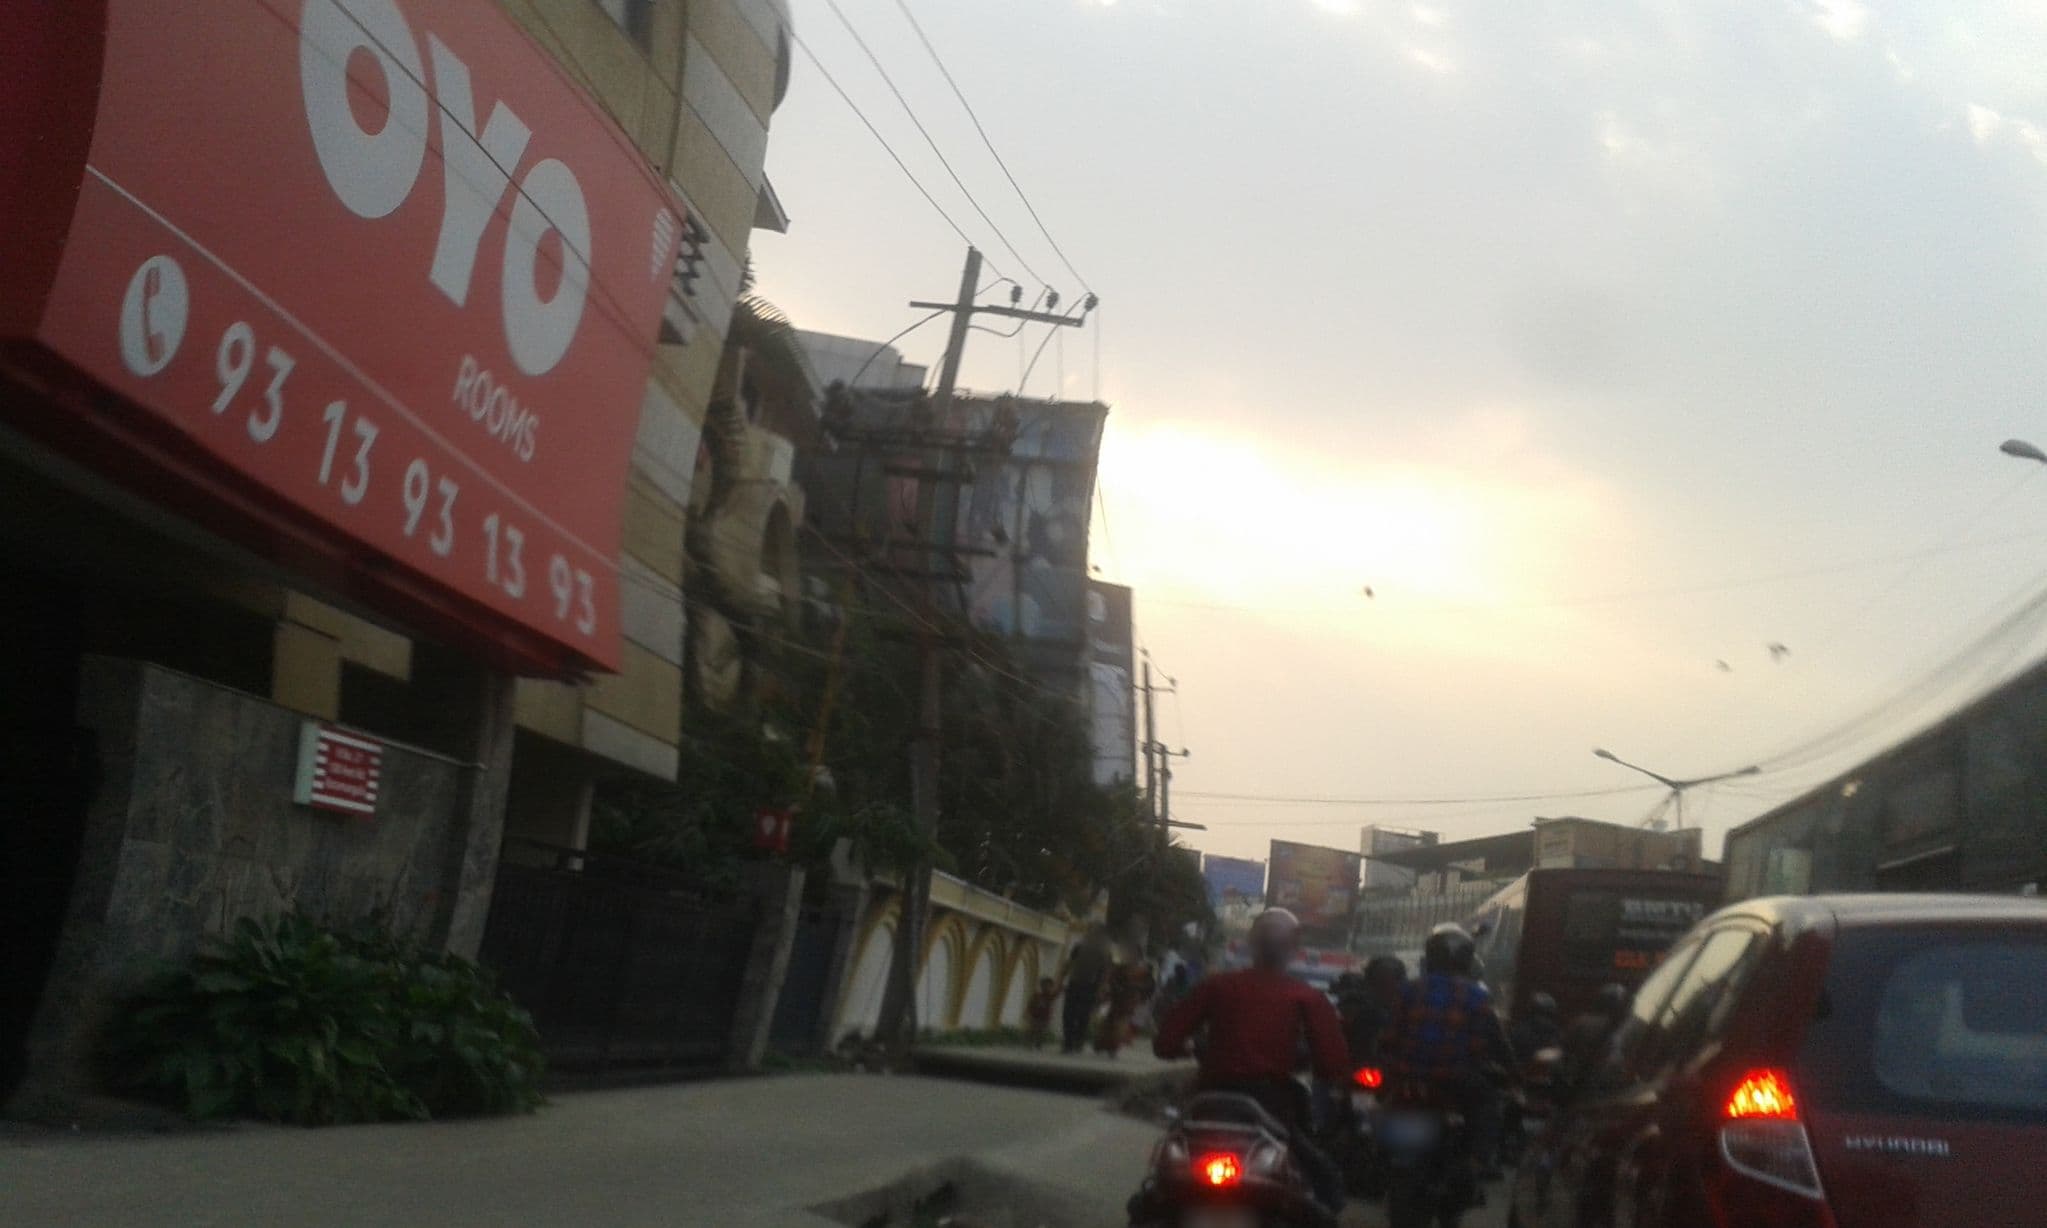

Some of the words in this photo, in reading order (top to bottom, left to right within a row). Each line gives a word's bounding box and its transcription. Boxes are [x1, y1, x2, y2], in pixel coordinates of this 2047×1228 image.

[300, 0, 592, 377] OYO
[211, 320, 297, 443] 93
[318, 400, 380, 505] 13
[402, 458, 460, 557] 93
[482, 513, 526, 599] 13
[548, 555, 597, 636] 93
[453, 354, 540, 463] ROOMS
